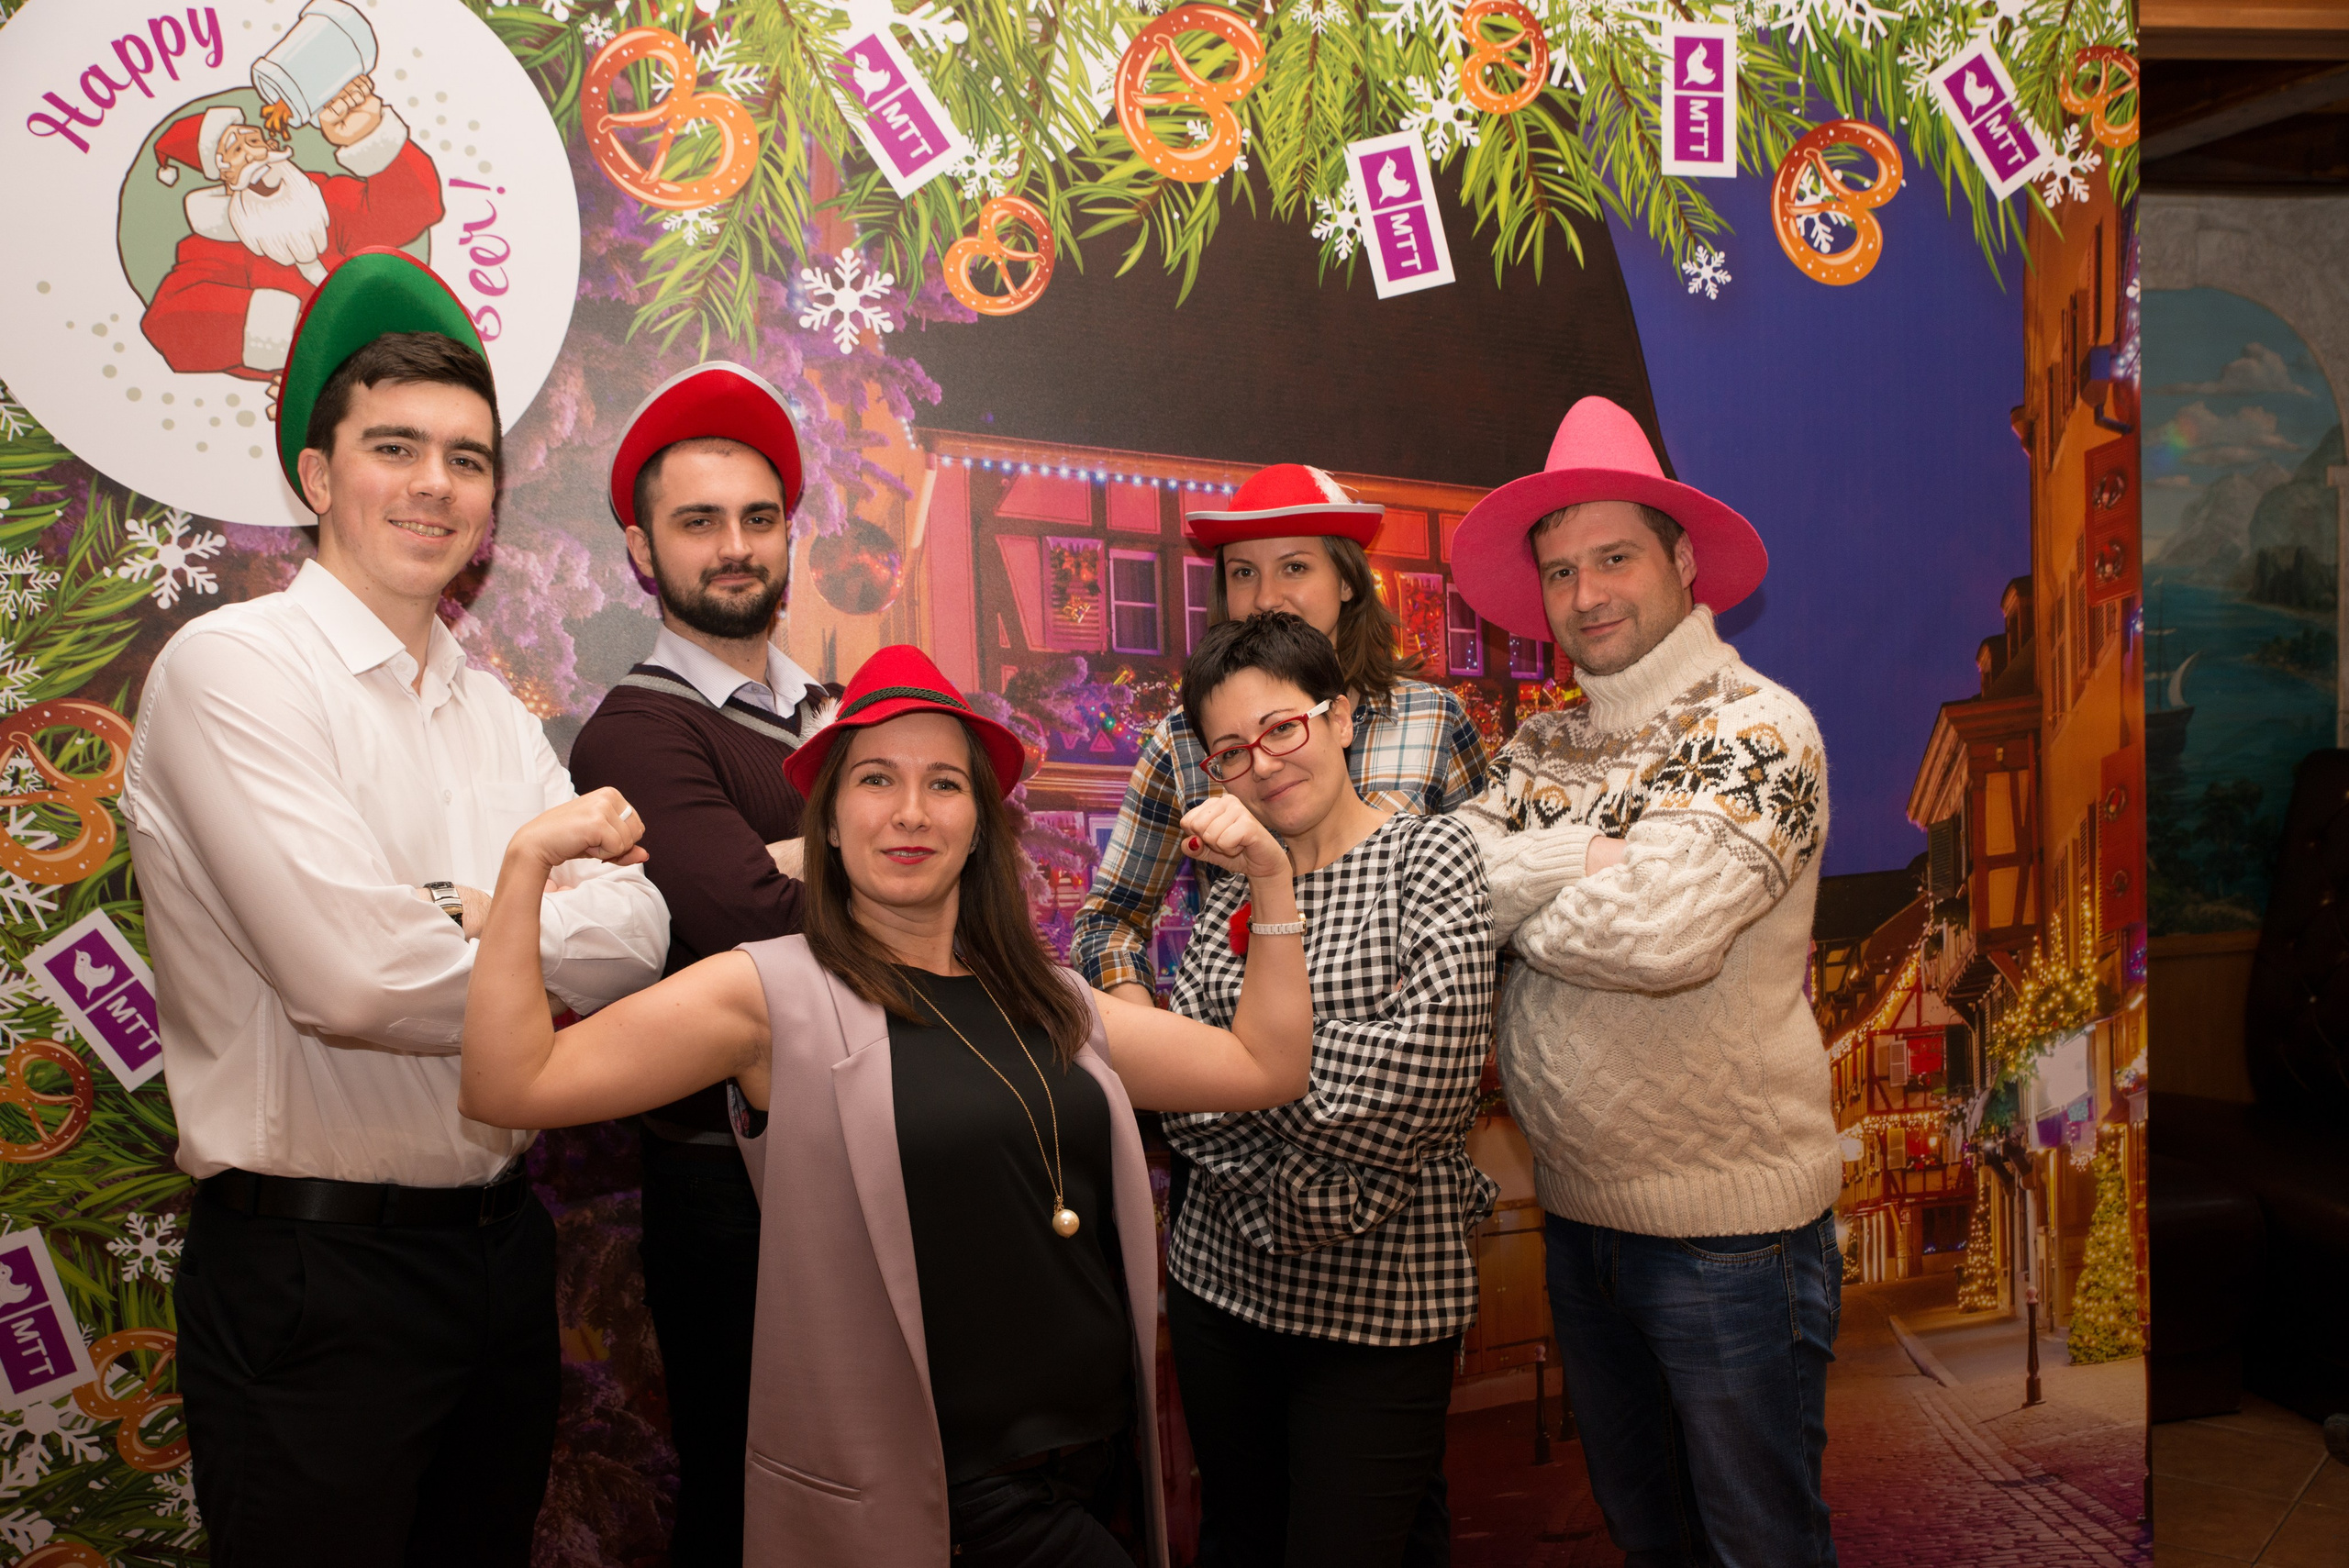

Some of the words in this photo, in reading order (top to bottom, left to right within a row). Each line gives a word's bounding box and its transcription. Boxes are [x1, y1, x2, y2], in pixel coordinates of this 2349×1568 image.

[27, 6, 224, 154] Happy
[881, 101, 933, 159] MTT
[1689, 99, 1709, 159] MTT
[1985, 113, 2027, 165] MTT
[1389, 212, 1422, 271] MTT
[106, 995, 162, 1051] MTT
[10, 1317, 55, 1376] MTT
